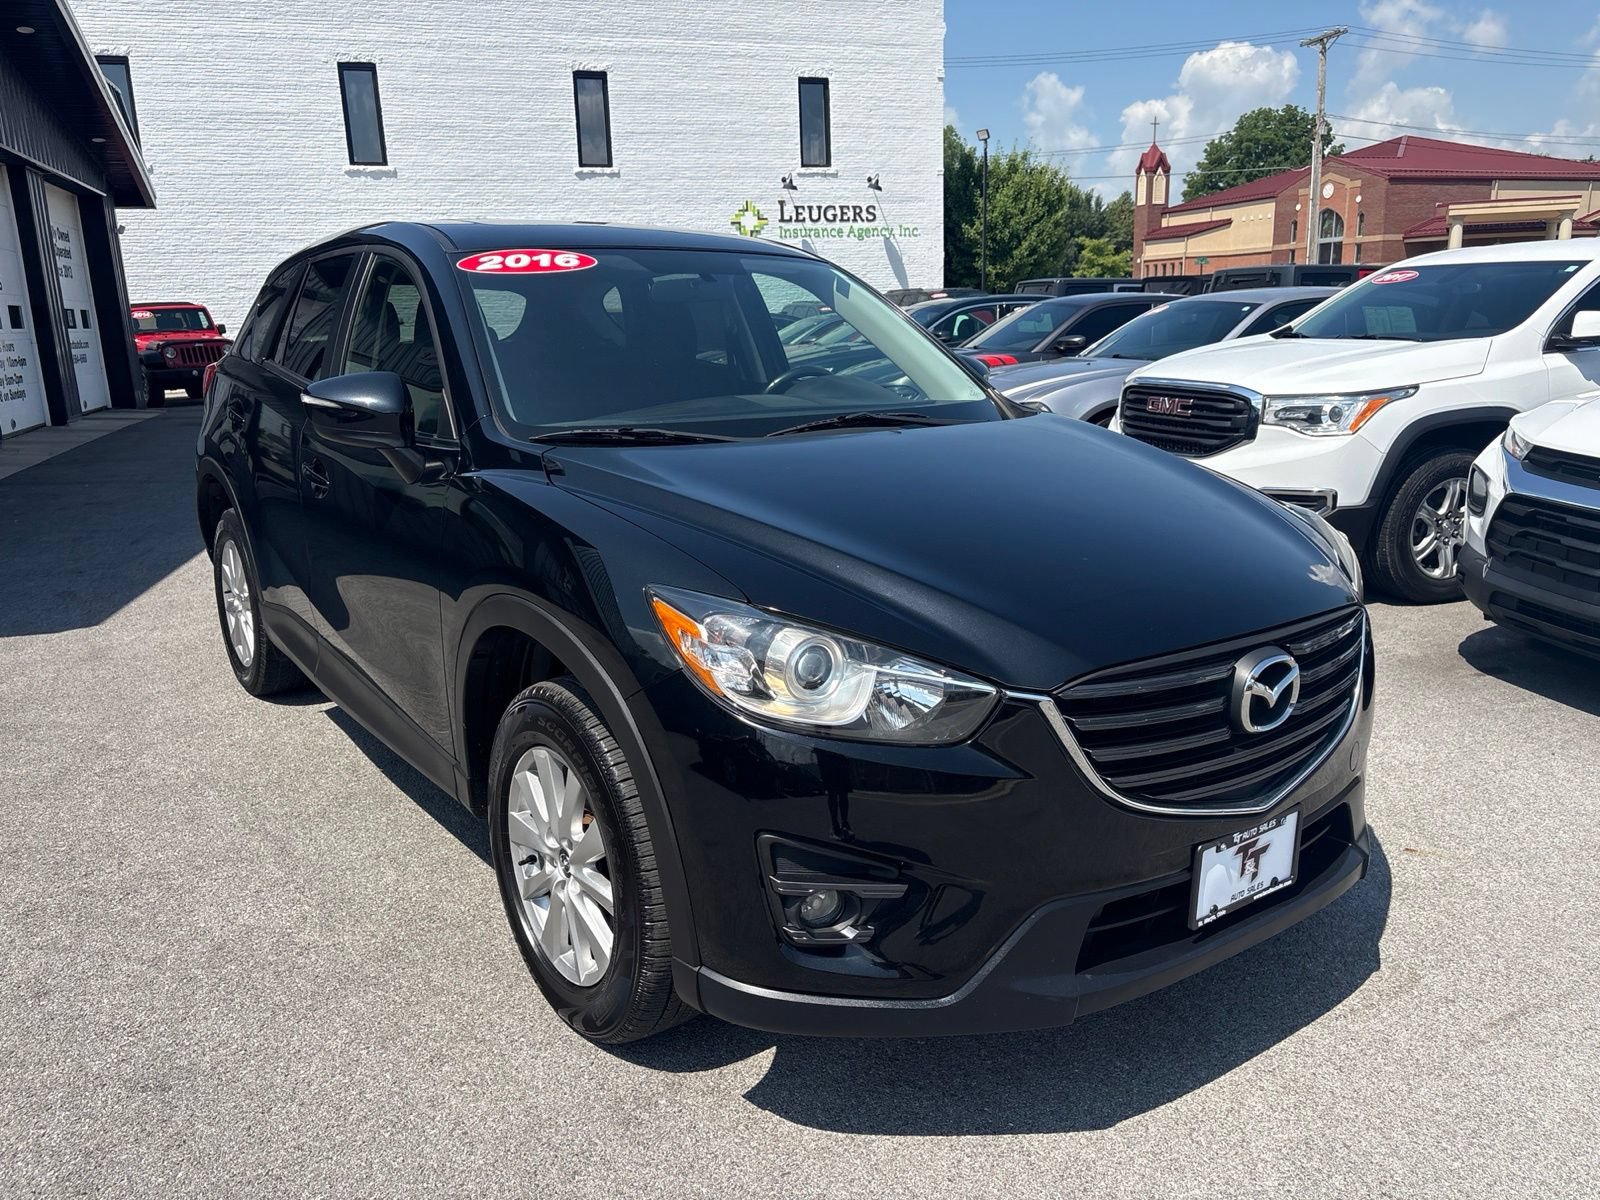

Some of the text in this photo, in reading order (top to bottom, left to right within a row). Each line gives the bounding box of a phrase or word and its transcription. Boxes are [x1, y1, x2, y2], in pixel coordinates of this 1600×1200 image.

[778, 200, 877, 223] LEUGERS
[779, 224, 921, 241] Insurance Agency, Inc.
[476, 253, 581, 271] 2016
[1147, 396, 1194, 416] GMC
[1242, 827, 1258, 841] AUTO
[1258, 818, 1277, 834] SALES
[1230, 889, 1246, 903] AUTO
[1246, 880, 1264, 895] SALES
